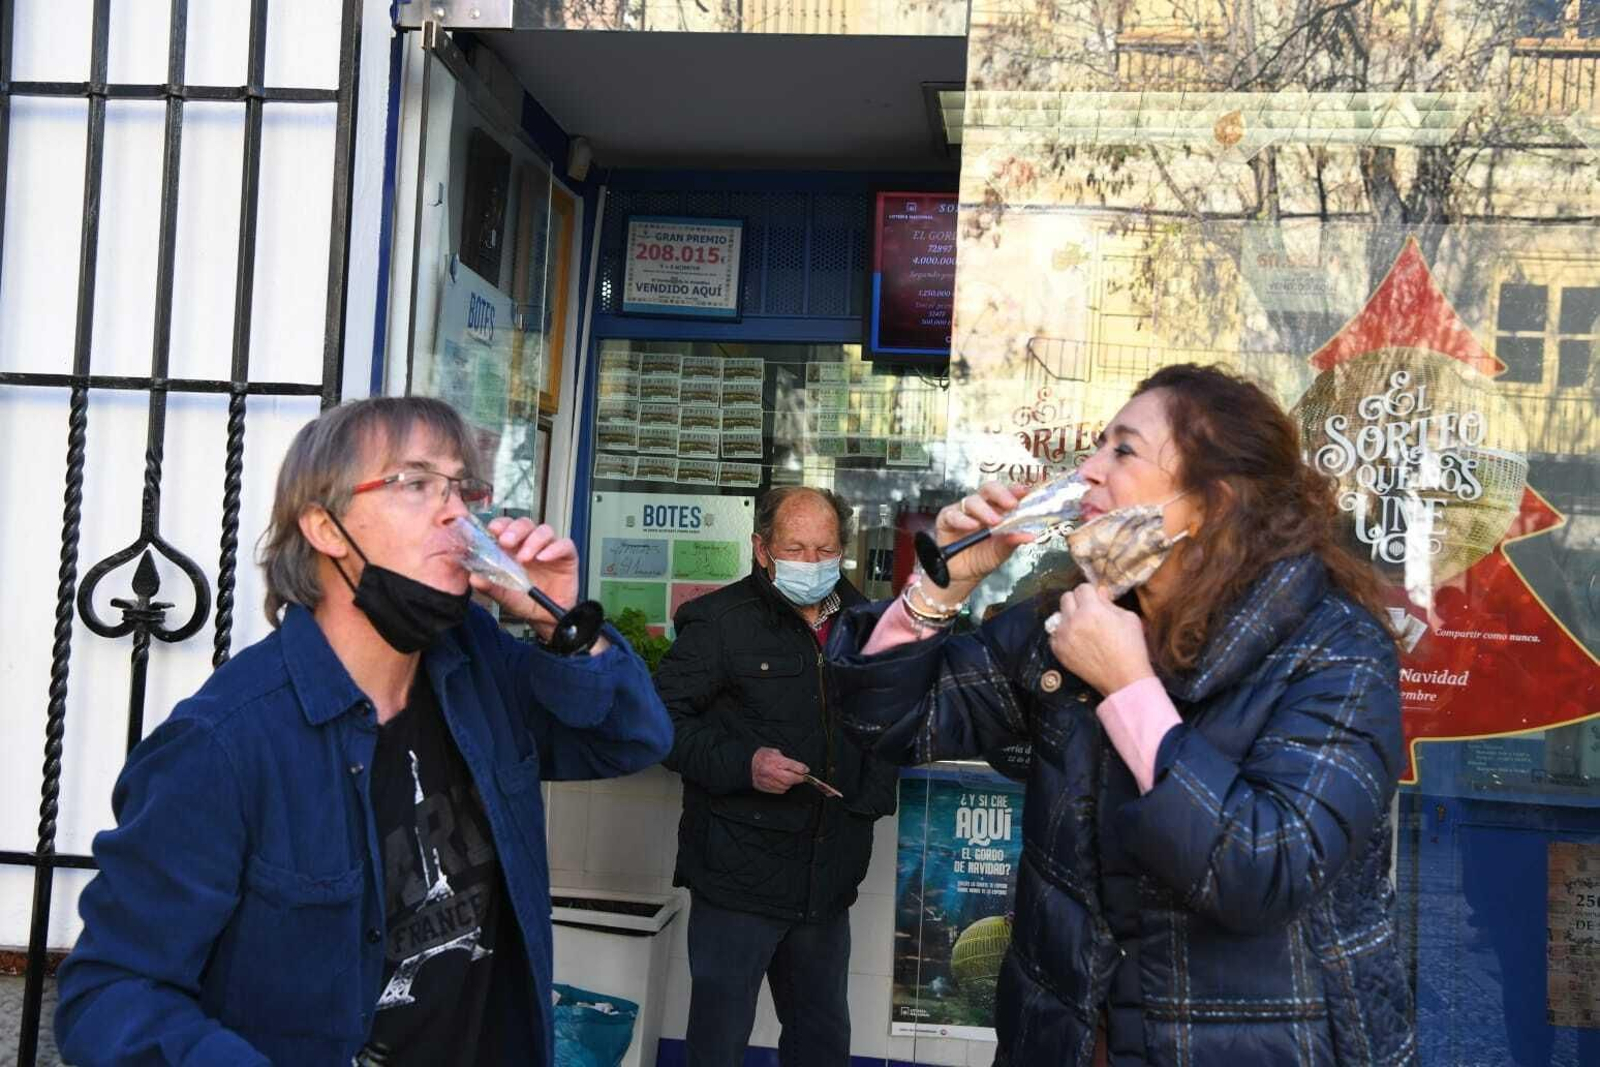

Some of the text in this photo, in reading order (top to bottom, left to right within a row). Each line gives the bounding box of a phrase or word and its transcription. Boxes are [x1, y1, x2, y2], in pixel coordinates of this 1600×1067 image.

[655, 232, 727, 244] GRAN PREMIO
[635, 282, 689, 294] VENDIDO
[692, 283, 722, 298] AQUÍ
[468, 291, 496, 340] BOTES
[1358, 370, 1431, 420] EL
[1315, 410, 1488, 477] SORTEO
[1356, 464, 1415, 495] QUE
[643, 504, 701, 529] BOTES
[1338, 491, 1448, 544] UNE
[1434, 628, 1541, 643] Compartir como nunca.
[1399, 668, 1470, 686] Navidad
[1401, 689, 1437, 702] embre
[978, 794, 988, 807] SI
[956, 807, 1013, 846] AQUÍ
[961, 848, 1004, 861] EL GORDO
[954, 860, 1011, 876] DE NAVIDAD?
